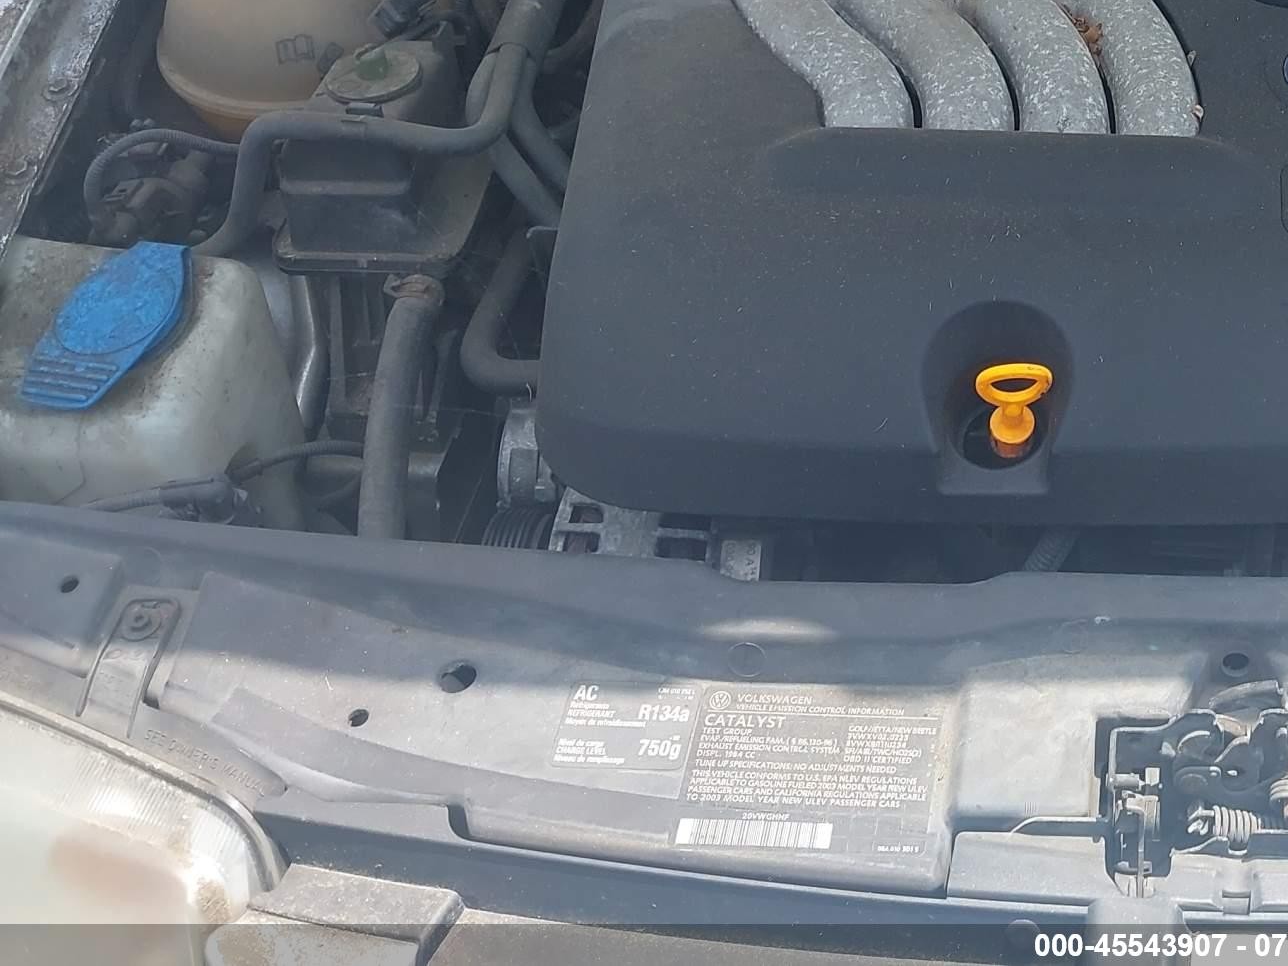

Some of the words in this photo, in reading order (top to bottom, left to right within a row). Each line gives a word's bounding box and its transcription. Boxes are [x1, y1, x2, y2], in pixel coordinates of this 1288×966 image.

[574, 685, 599, 701] AC
[737, 694, 814, 705] VOLKSWAGEN
[638, 704, 690, 722] R134a
[808, 706, 846, 714] CONTROL
[848, 707, 905, 716] INFORMATION
[704, 713, 787, 728] CATALYST
[723, 728, 752, 736] GROUP
[637, 739, 683, 761] 750g
[698, 743, 734, 751] EXHAUST
[735, 744, 771, 752] EMISSION
[772, 744, 809, 753] CONTROL
[695, 759, 716, 767] TUNE
[808, 764, 865, 772] ADJUSTMENTS
[866, 765, 898, 774] NEEDED
[689, 777, 736, 785] APPLICABLE
[787, 781, 818, 789] FUELED
[692, 769, 711, 777] THIS
[712, 771, 744, 779] VEHICLE
[745, 772, 793, 780] CONFORMS
[793, 773, 805, 781] TO
[823, 774, 838, 782] EPA
[839, 775, 861, 783] NLEV
[861, 776, 918, 785] REGULATIONS
[686, 793, 699, 801] TO
[723, 794, 755, 802] MODEL
[805, 797, 828, 805] ULEV
[829, 798, 877, 807] PASSENGER
[878, 800, 901, 808] CARS
[687, 786, 732, 794] PASSENGER
[774, 789, 822, 798] CALIFORNIA
[823, 791, 880, 799] REGULATIONS
[880, 793, 927, 801] APPLICABLE
